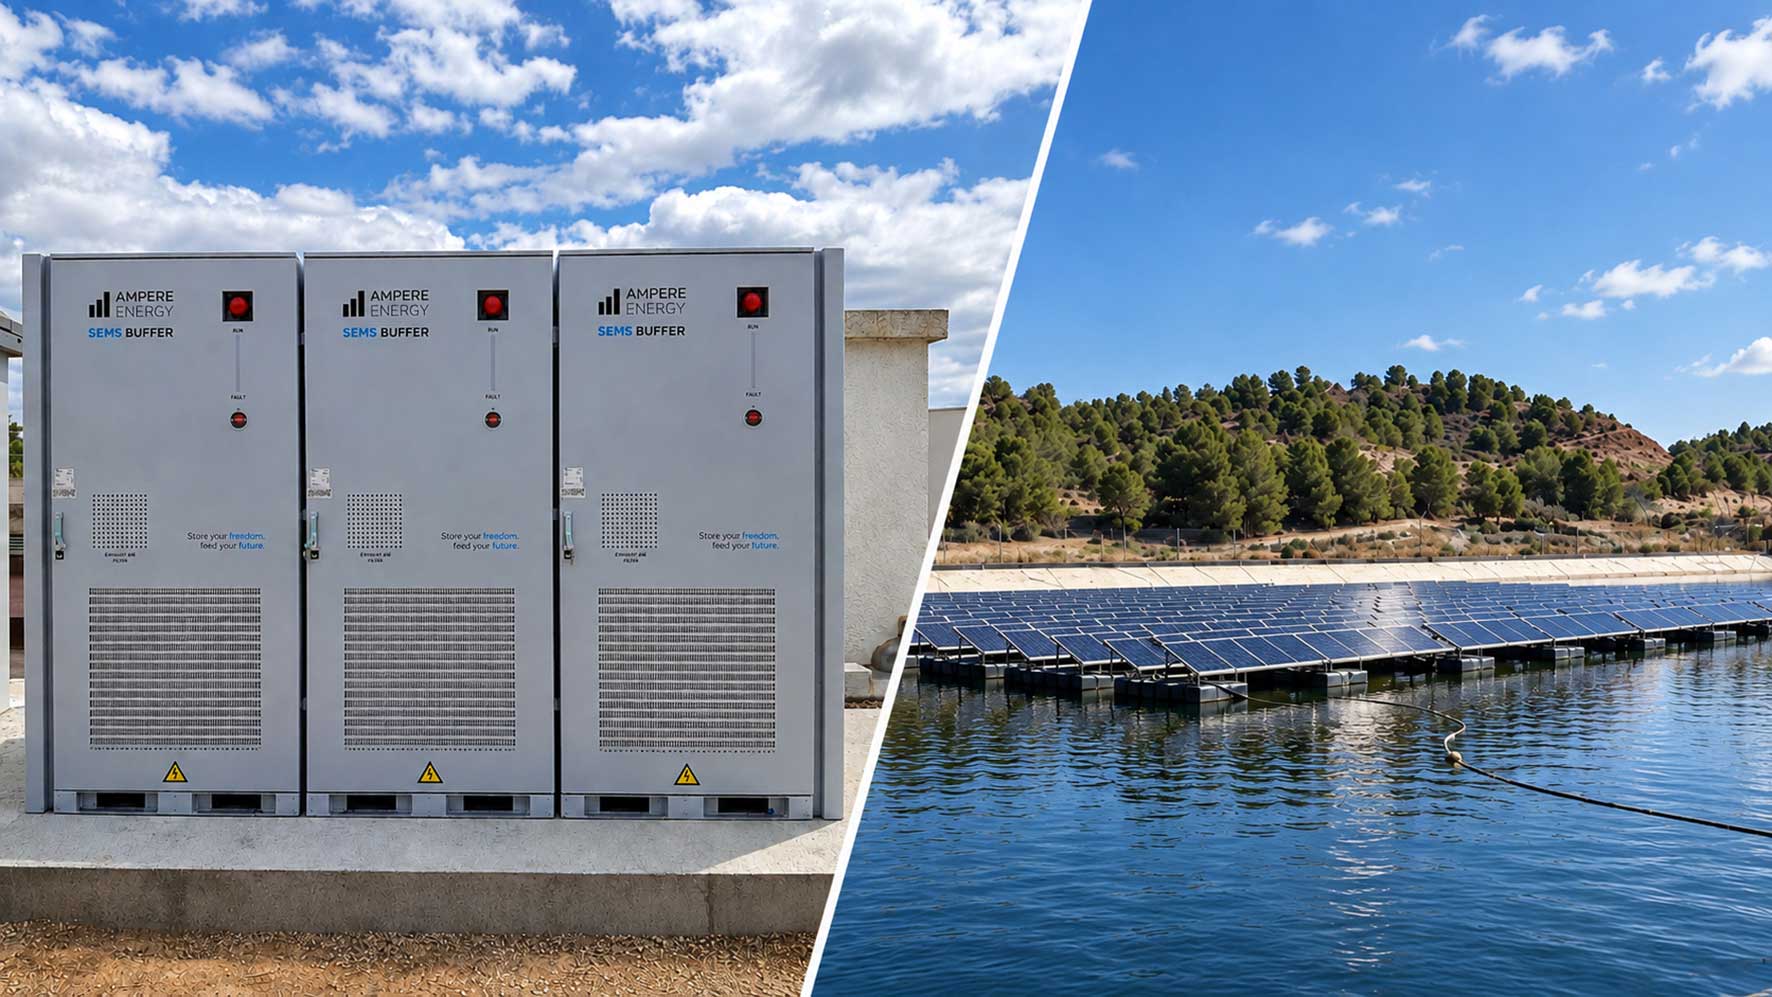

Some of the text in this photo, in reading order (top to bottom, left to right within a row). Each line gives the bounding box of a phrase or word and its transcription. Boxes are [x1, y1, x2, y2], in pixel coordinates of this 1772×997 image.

[116, 291, 173, 302] AMPERE
[370, 290, 429, 301] AMPERE
[626, 288, 686, 299] AMPERE
[116, 305, 173, 318] ENERGY
[371, 305, 429, 317] ENERGY
[626, 302, 686, 315] ENERGY
[89, 328, 173, 338] SEMS BUFFER
[343, 327, 429, 338] SEMS BUFFER
[598, 326, 685, 336] SEMS BUFFER
[187, 532, 208, 540] Store
[441, 532, 462, 540] Store
